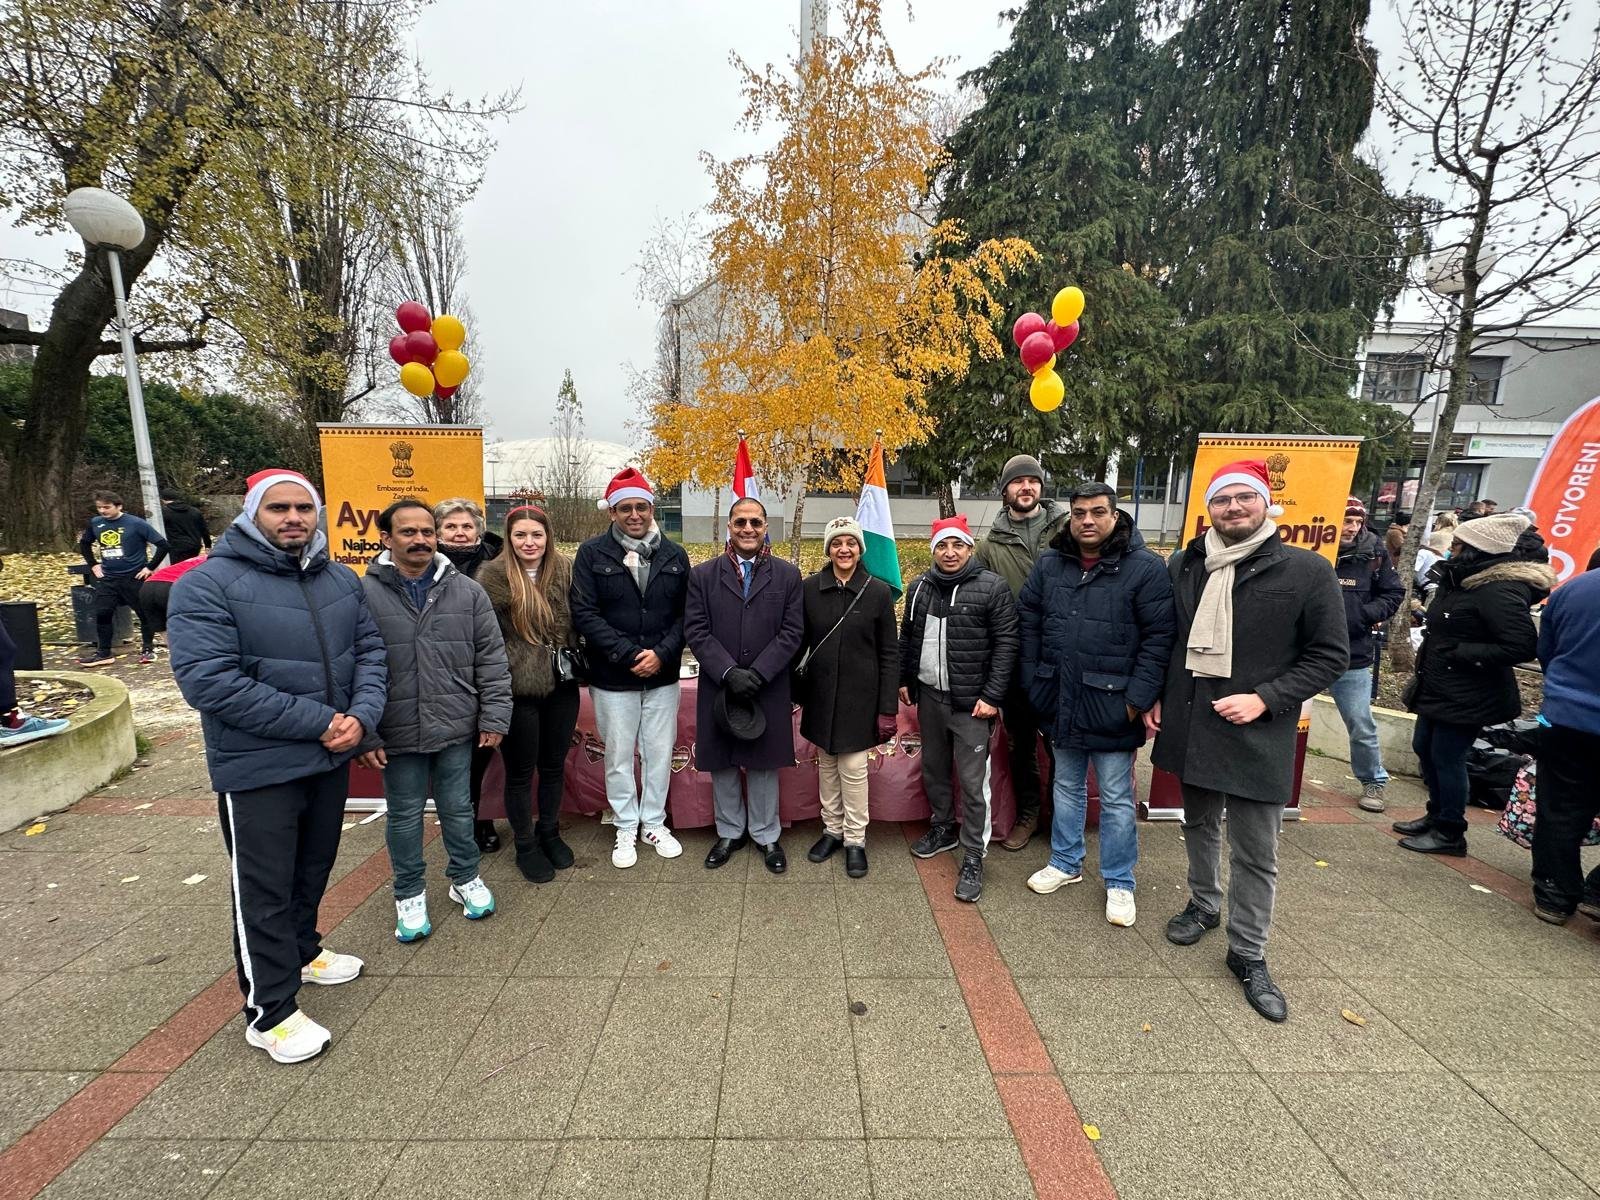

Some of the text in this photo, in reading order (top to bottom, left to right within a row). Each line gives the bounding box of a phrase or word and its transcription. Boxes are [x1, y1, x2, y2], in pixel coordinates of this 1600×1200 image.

[376, 484, 405, 493] Embassy
[1551, 442, 1600, 538] OTVORENI
[342, 538, 383, 554] Najbol
